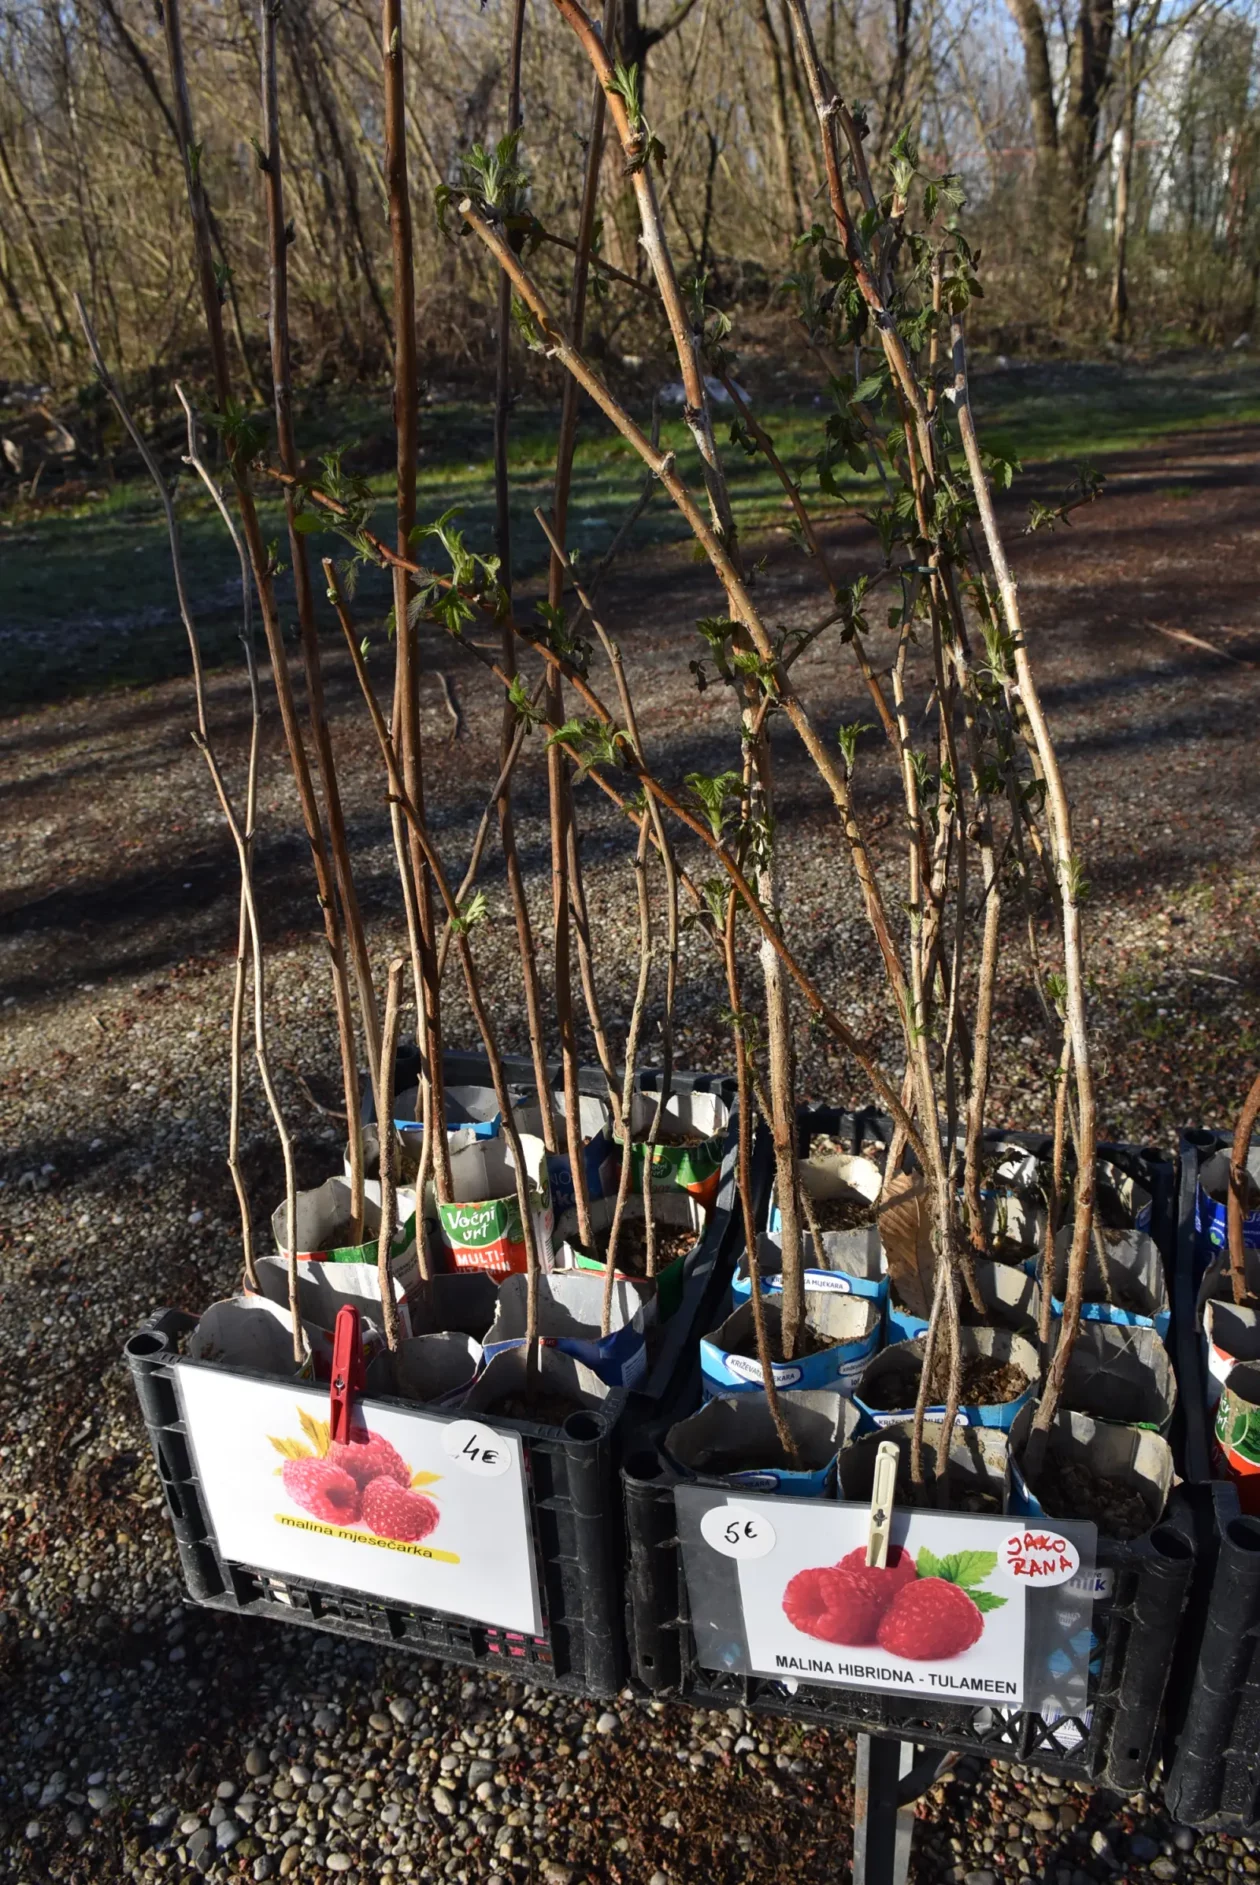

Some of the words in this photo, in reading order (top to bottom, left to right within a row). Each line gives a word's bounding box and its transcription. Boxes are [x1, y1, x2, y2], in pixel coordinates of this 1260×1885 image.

[446, 1206, 496, 1230] Voćni
[462, 1222, 490, 1241] vrt
[456, 1249, 505, 1267] MULTI-
[280, 1516, 334, 1536] malina
[338, 1530, 433, 1559] mjesečarka
[723, 1520, 759, 1545] 5€
[1006, 1555, 1074, 1578] RANA
[774, 1654, 835, 1675] MALINA
[838, 1663, 915, 1684] HIBRIDNA
[928, 1673, 1019, 1696] TULAMEEN
